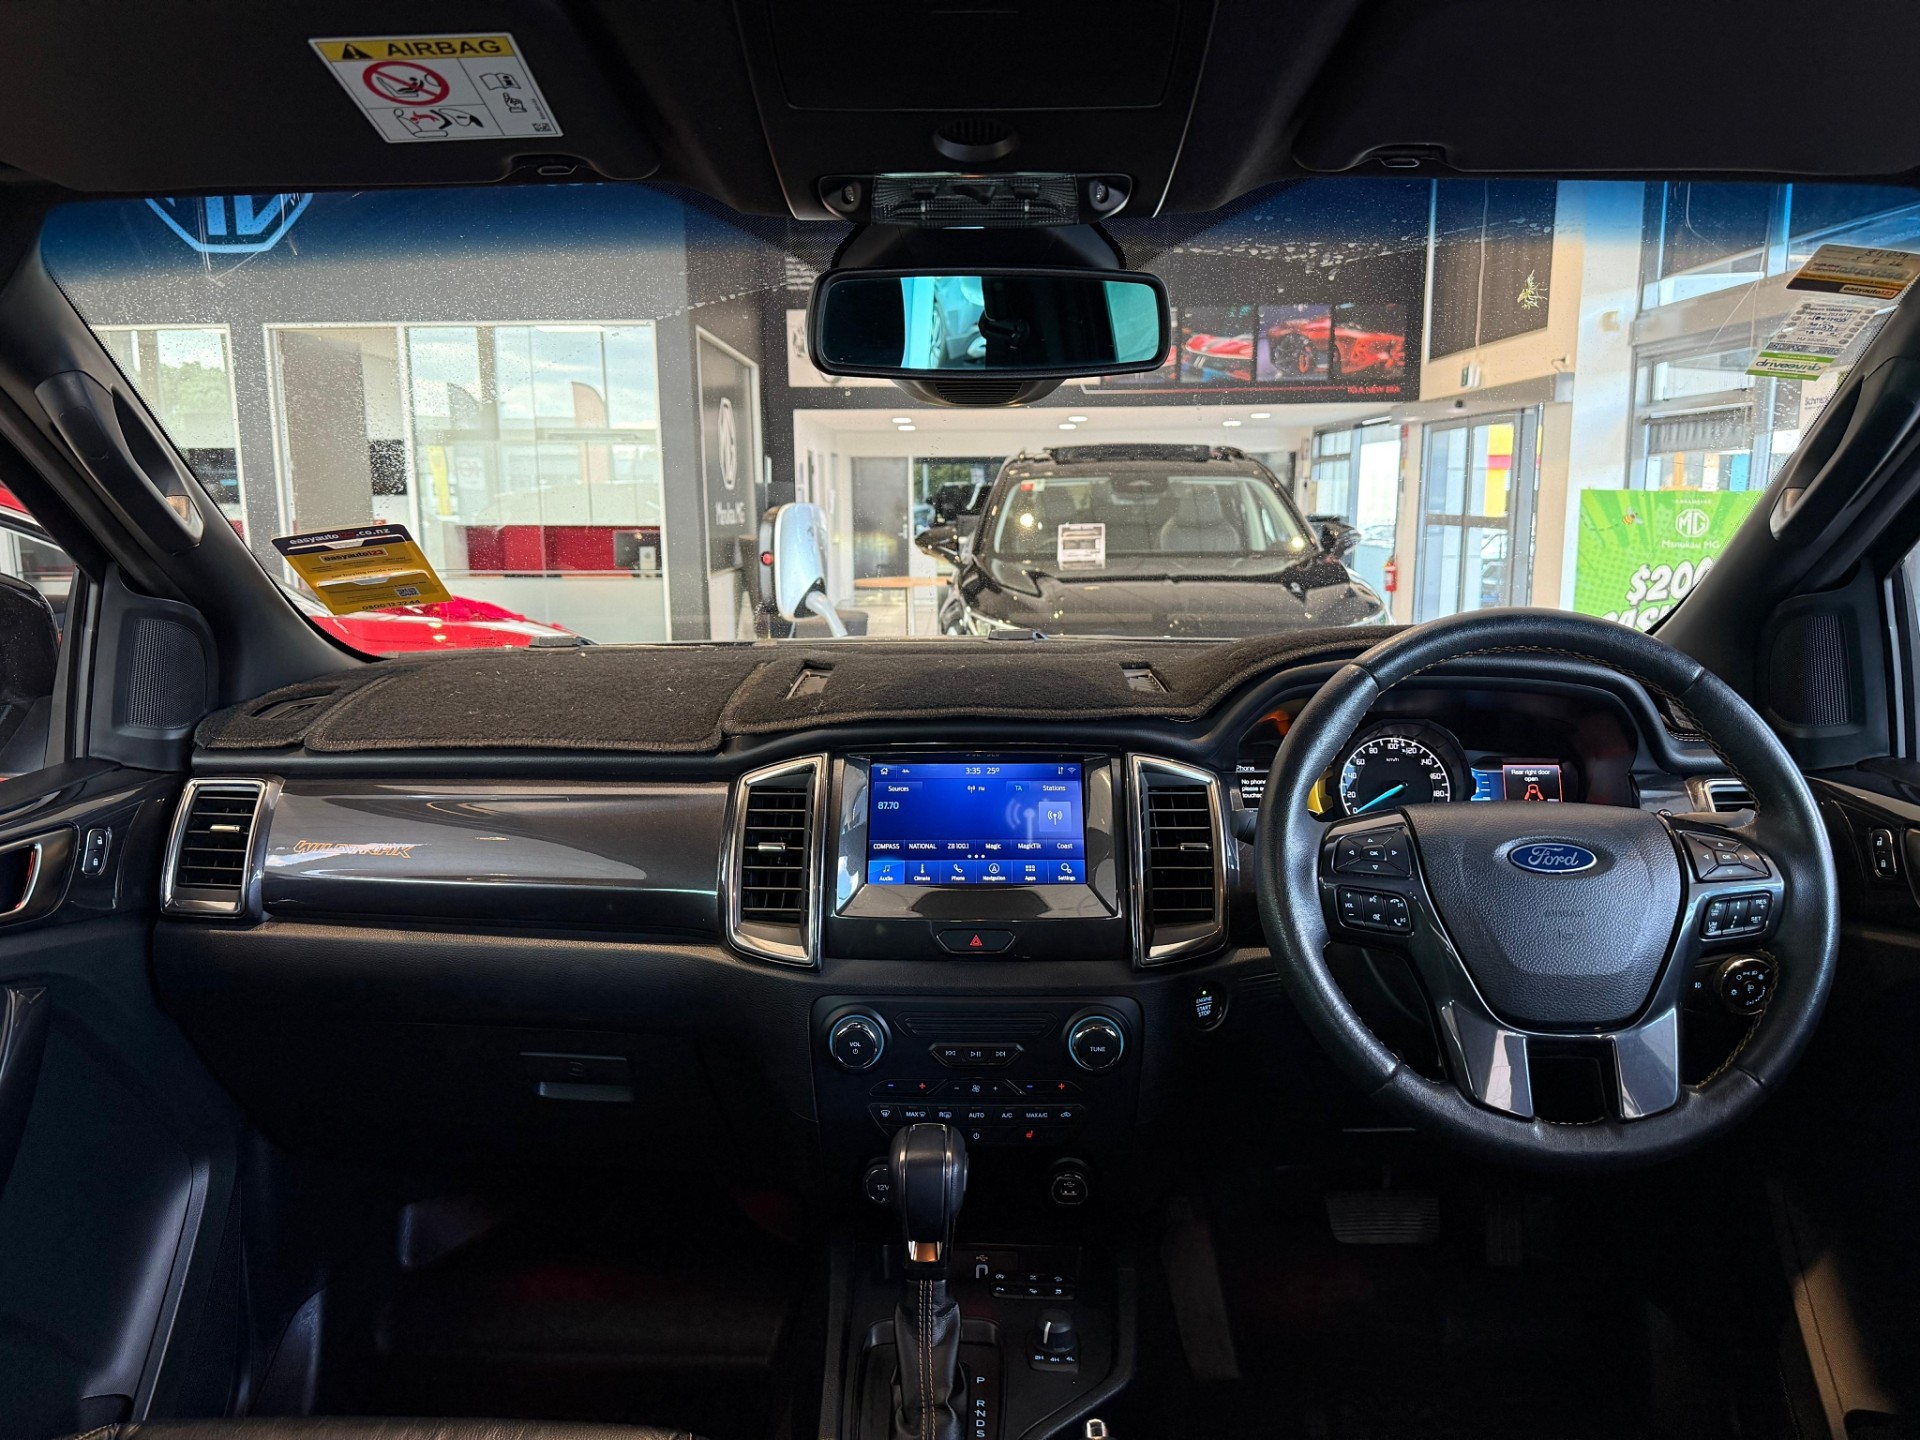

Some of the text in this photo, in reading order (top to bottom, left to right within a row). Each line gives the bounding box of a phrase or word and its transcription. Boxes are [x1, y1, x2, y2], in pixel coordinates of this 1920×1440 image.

[386, 39, 502, 56] AIRBAG
[1677, 510, 1707, 536] MG
[1704, 540, 1720, 549] MG
[324, 549, 384, 562] easyauto123
[362, 603, 387, 611] 0800
[965, 767, 982, 775] 3:35
[1042, 784, 1067, 792] Stations
[877, 801, 899, 810] 87.70
[985, 842, 1002, 850] Magic
[1056, 842, 1073, 850] Coast
[1527, 846, 1579, 867] Ford
[1196, 1004, 1212, 1012] START
[976, 1376, 986, 1384] P
[976, 1399, 986, 1407] R
[976, 1409, 986, 1417] N
[975, 1419, 986, 1427] D
[976, 1429, 986, 1438] S
